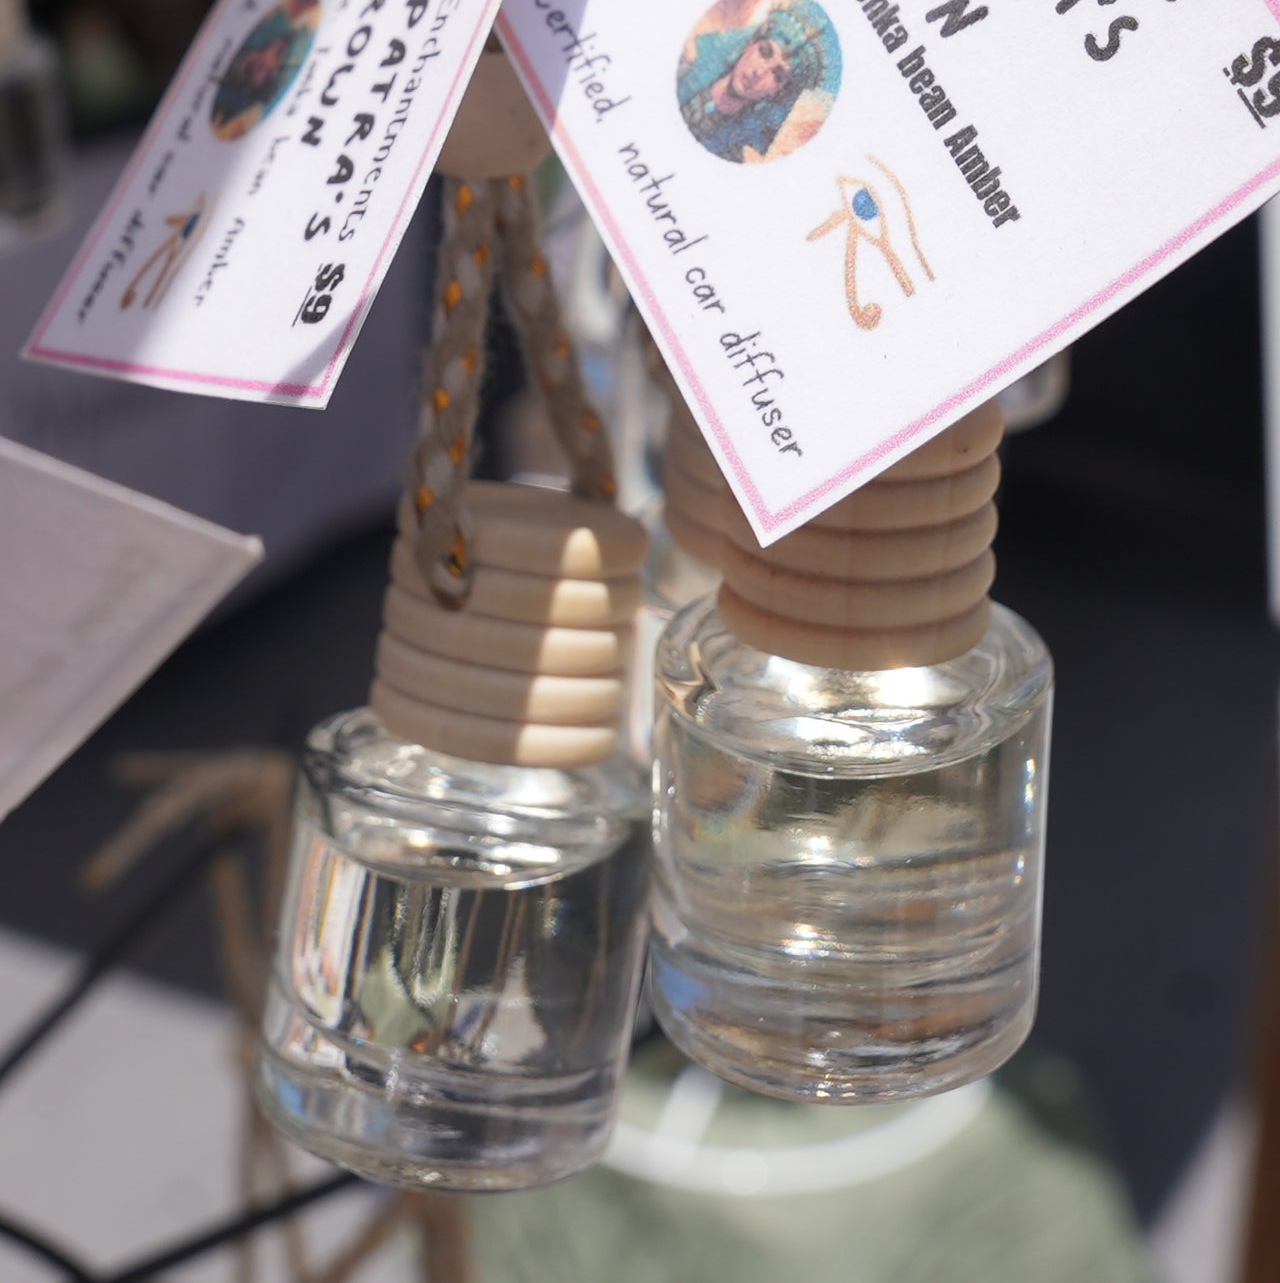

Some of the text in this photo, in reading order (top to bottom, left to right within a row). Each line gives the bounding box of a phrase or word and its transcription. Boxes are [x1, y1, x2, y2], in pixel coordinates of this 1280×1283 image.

[896, 45, 957, 130] bean
[943, 124, 1020, 228] Amber
[292, 263, 345, 327] $9
[619, 142, 710, 255] natural
[685, 266, 726, 316] car
[720, 330, 803, 458] diffuser
